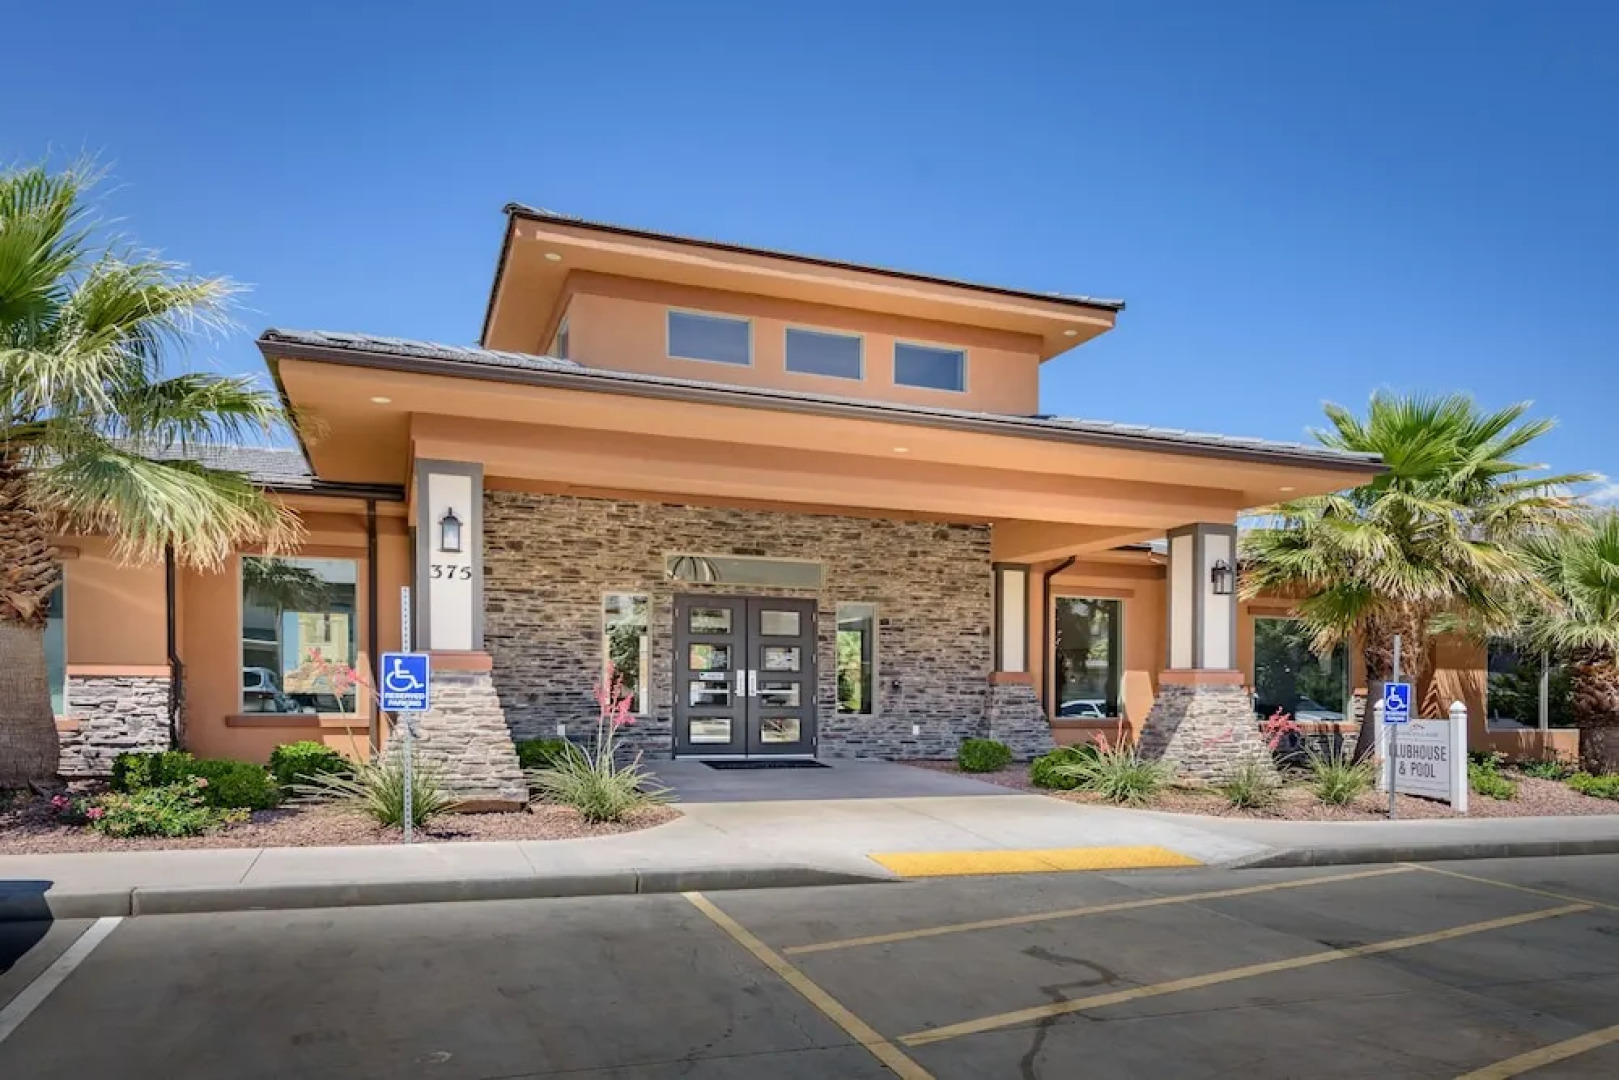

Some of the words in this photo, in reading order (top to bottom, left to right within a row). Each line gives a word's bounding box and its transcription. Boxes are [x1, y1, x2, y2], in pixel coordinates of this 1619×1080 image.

[429, 564, 472, 580] 375
[1399, 761, 1406, 775] &
[1411, 762, 1436, 778] POOL
